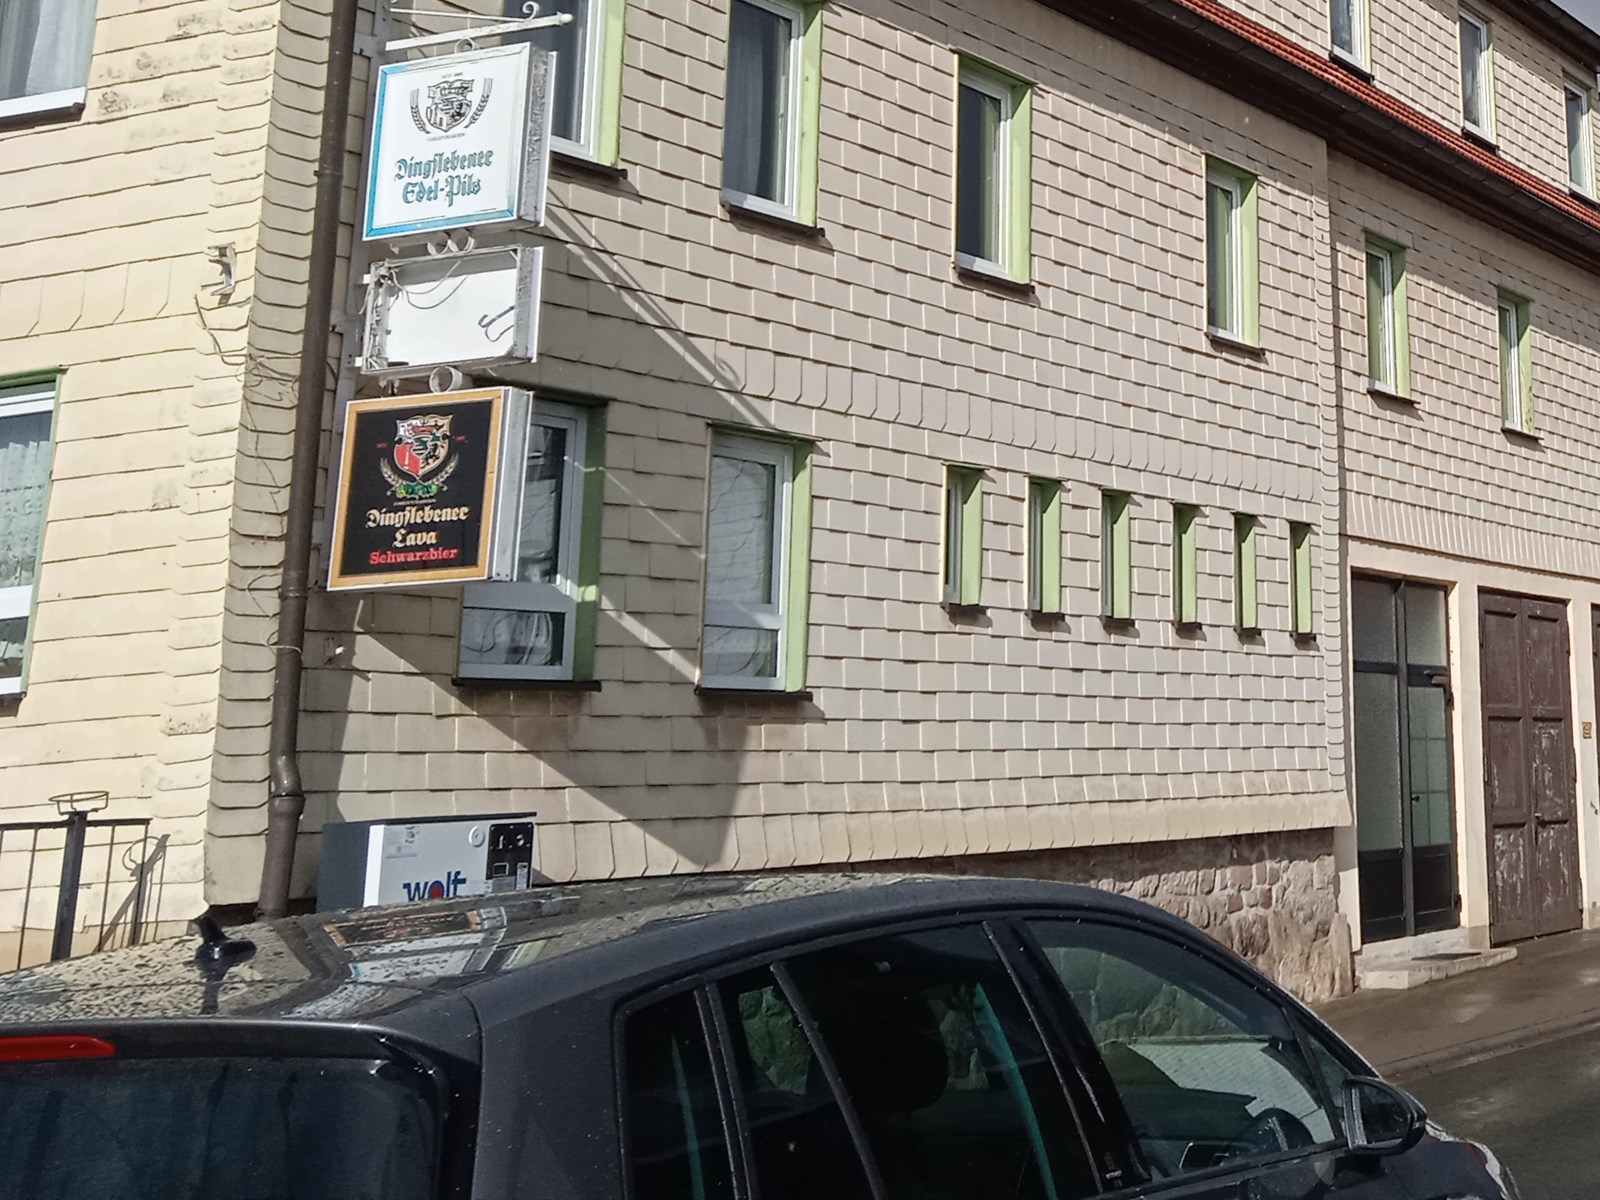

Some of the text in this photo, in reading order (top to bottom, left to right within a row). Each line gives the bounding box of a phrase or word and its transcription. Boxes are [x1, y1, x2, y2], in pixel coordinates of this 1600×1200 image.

[402, 173, 481, 208] Edel-Pils
[392, 528, 438, 548] Lava
[369, 547, 458, 565] Schwarzbier
